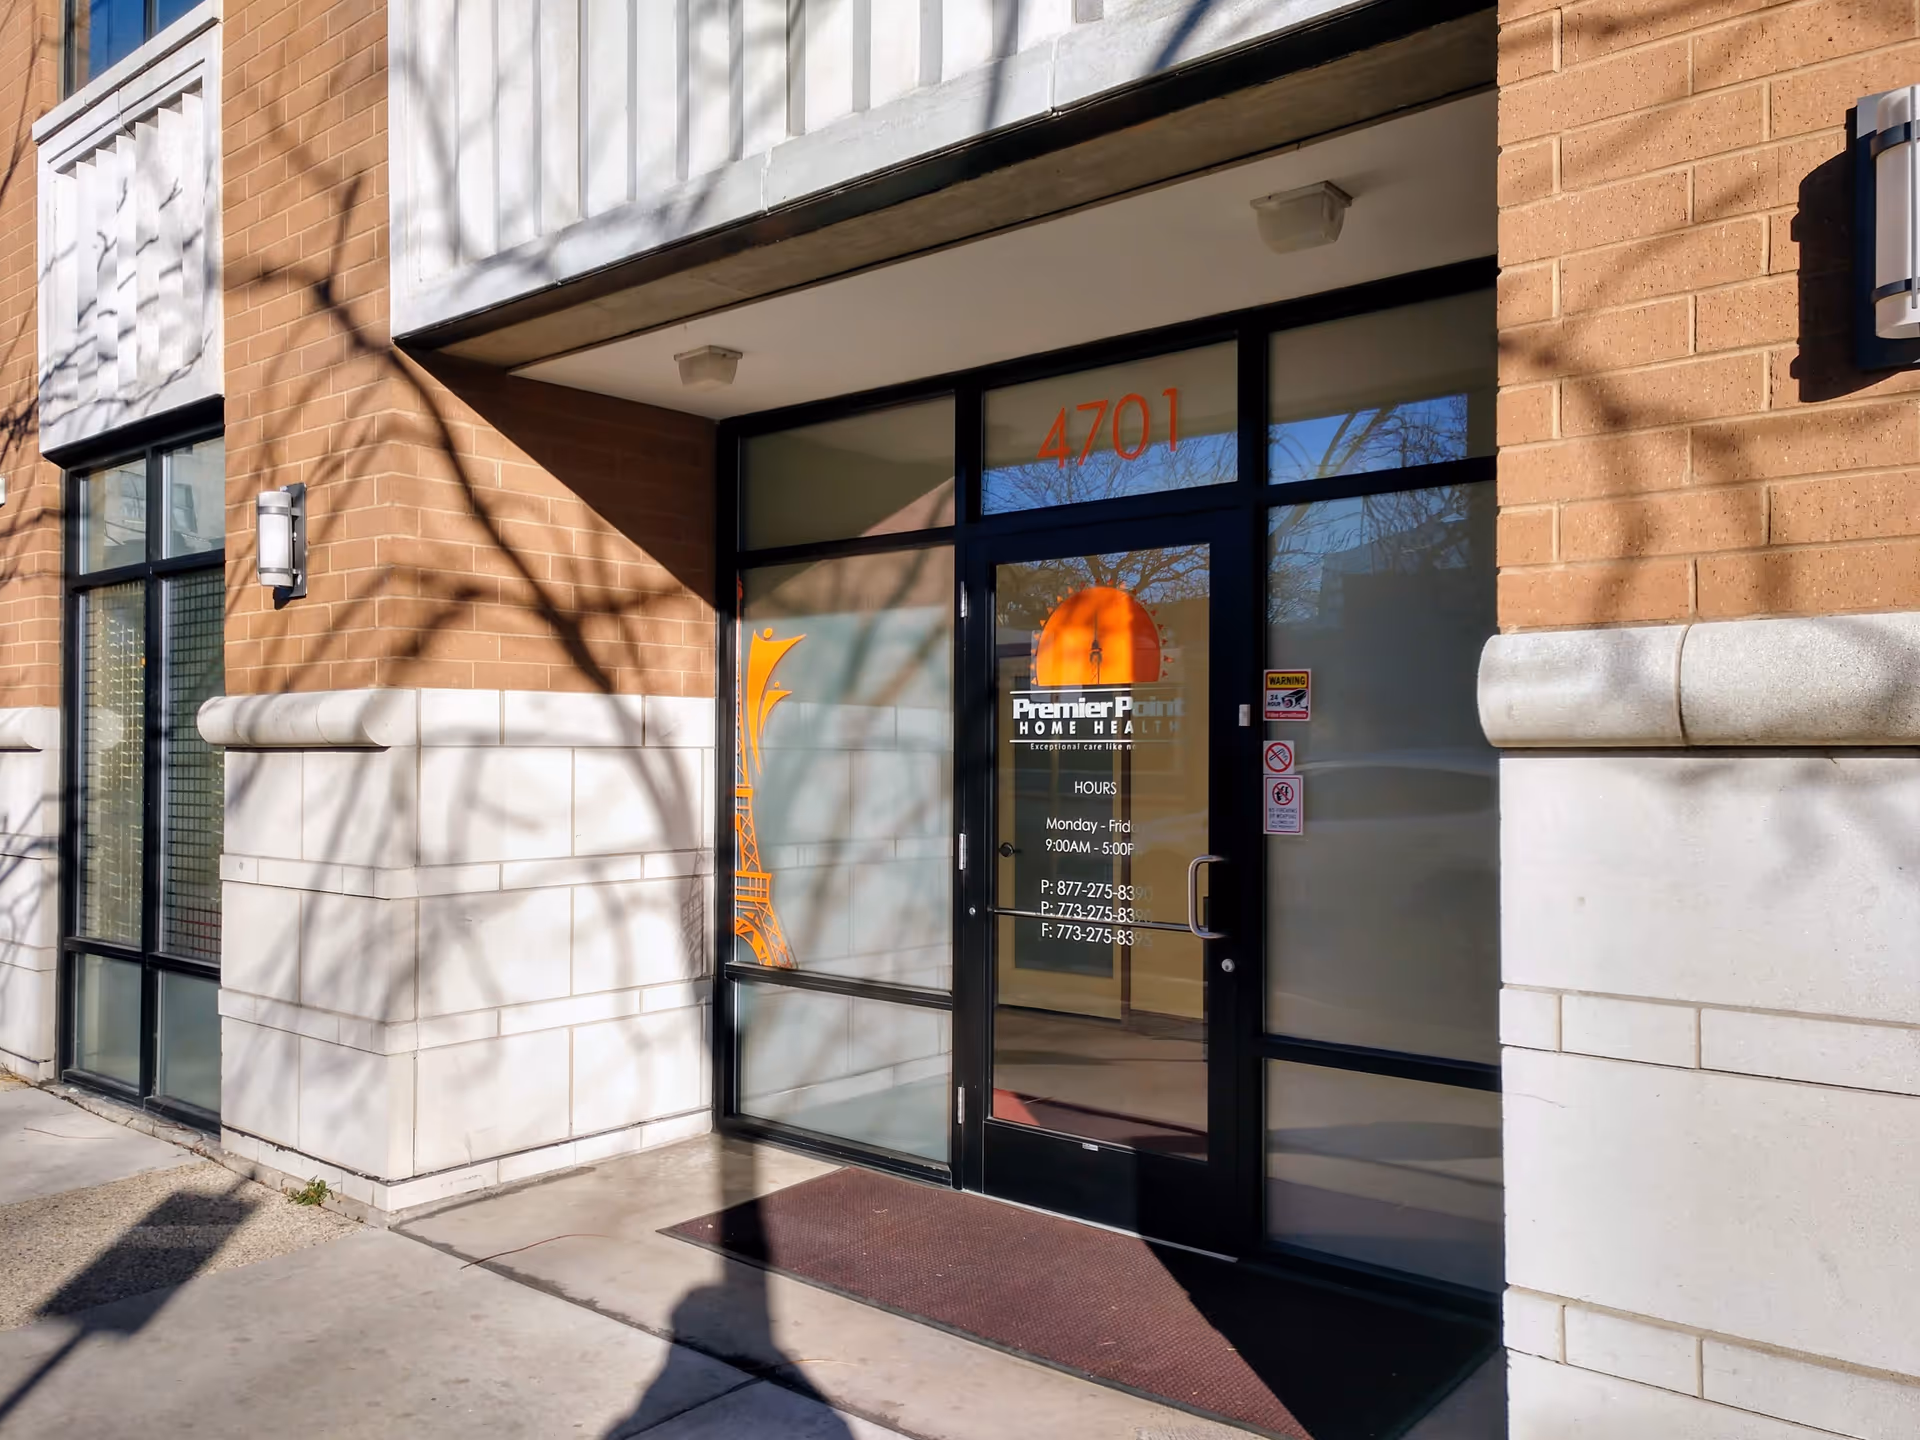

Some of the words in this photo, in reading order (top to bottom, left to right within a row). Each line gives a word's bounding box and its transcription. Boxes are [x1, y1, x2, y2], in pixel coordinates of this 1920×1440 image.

[1036, 387, 1178, 469] 4701
[1269, 676, 1306, 686] WARNING
[1012, 697, 1113, 719] Premier
[1115, 696, 1186, 718] Point
[1019, 721, 1077, 735] HOME
[1094, 720, 1181, 735] HEALTH
[1030, 743, 1080, 752] Exceptional
[1084, 743, 1103, 751] care
[1105, 742, 1123, 751] like
[1074, 781, 1117, 795] HOURS
[1046, 817, 1098, 834] Monday
[1045, 839, 1091, 854] 9:00AM
[1041, 880, 1054, 895] P:
[1041, 901, 1054, 916] P:
[1041, 922, 1053, 938] F:
